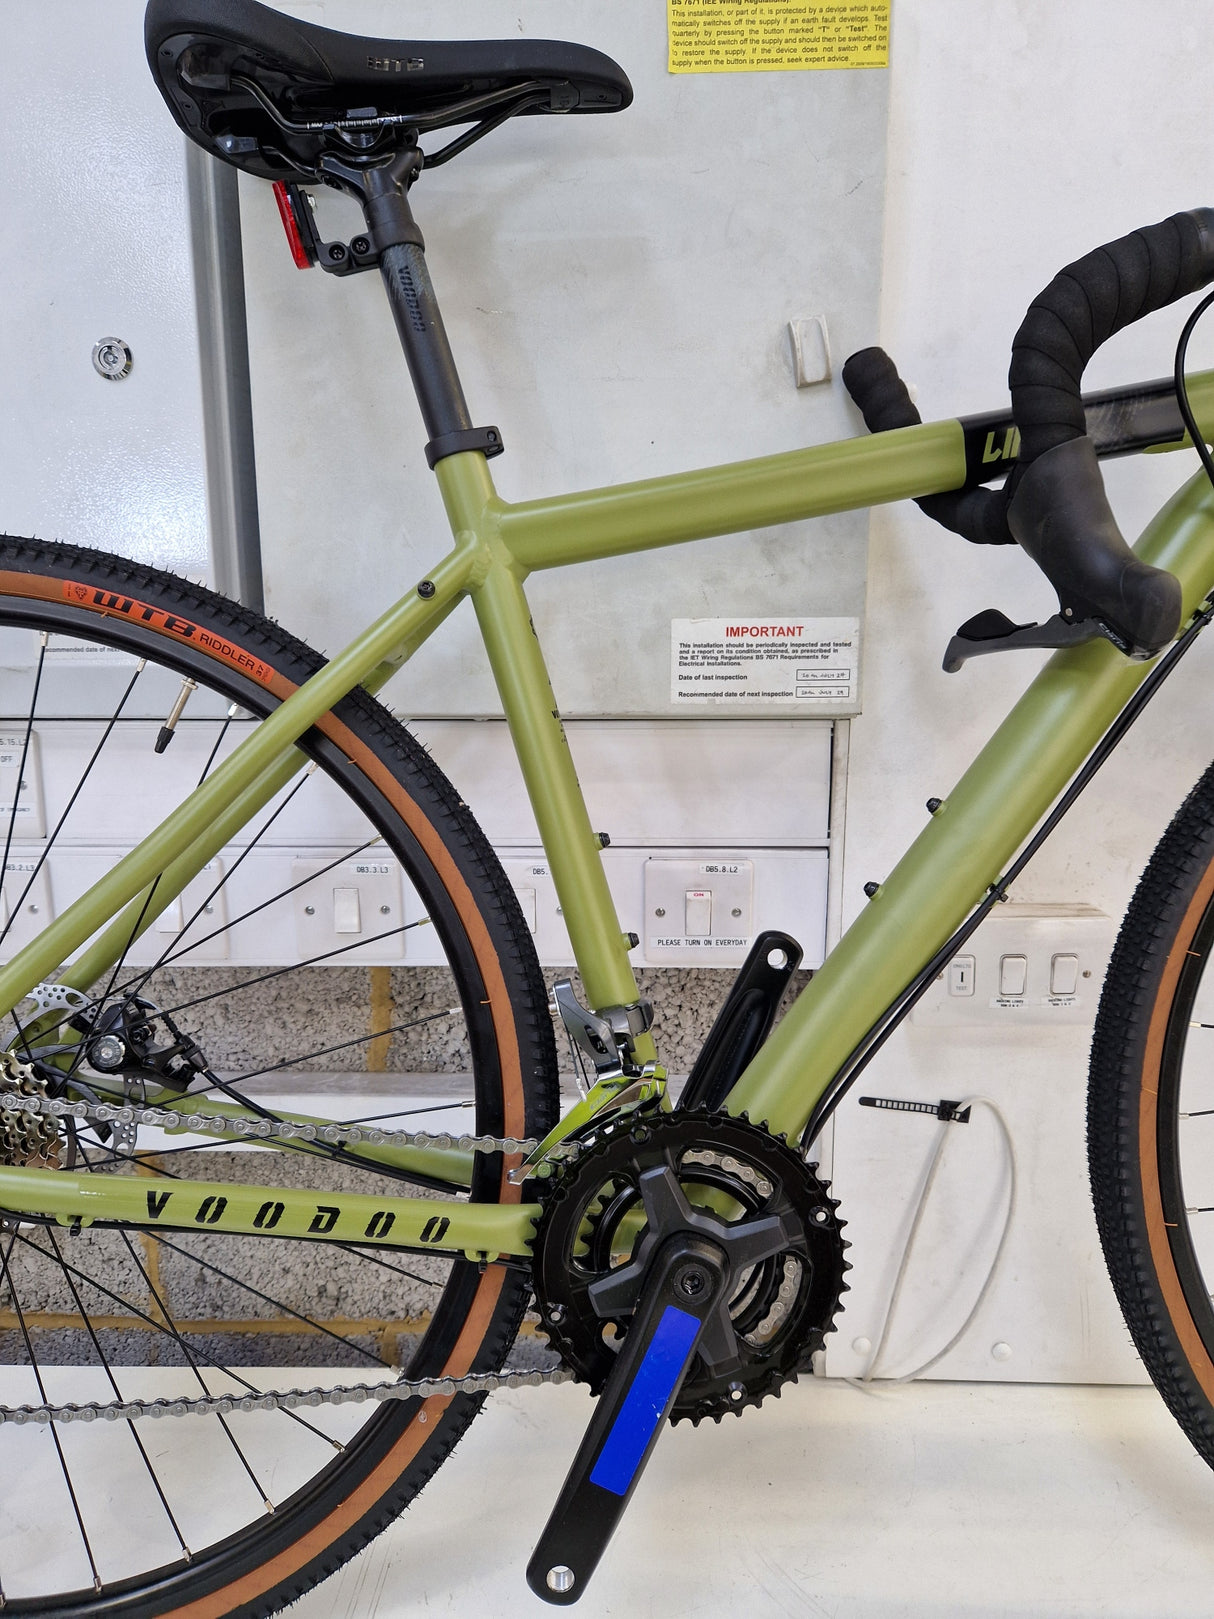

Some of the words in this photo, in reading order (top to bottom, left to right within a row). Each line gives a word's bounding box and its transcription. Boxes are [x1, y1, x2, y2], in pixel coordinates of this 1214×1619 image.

[725, 626, 804, 637] IMPORTANT
[200, 633, 255, 670] RIDDLER
[147, 1190, 450, 1243] VOODOO
